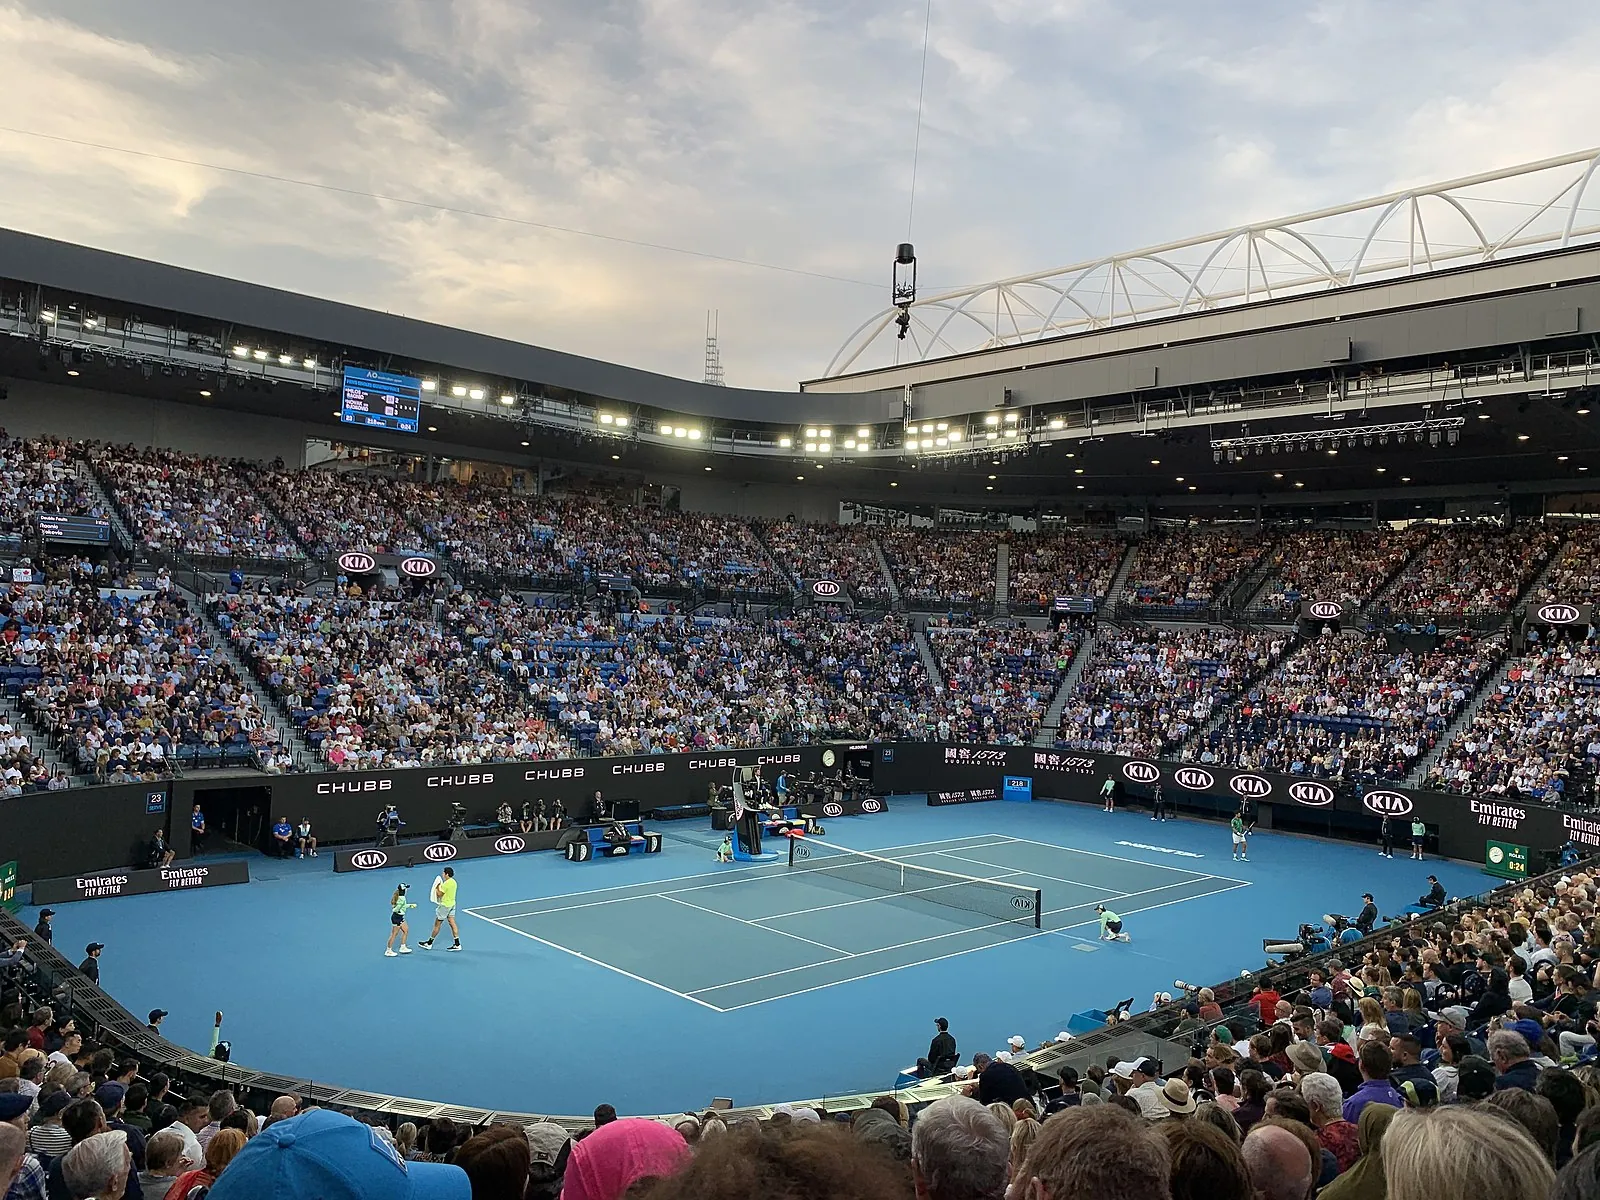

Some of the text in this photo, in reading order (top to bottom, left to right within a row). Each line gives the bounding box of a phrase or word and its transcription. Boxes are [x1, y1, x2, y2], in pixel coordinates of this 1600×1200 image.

[345, 556, 369, 569] KIA
[408, 561, 430, 573] KIA
[817, 583, 835, 593] KIA
[1316, 604, 1338, 615] KIA
[1545, 608, 1573, 620] KIA
[757, 754, 801, 765] CHUBB
[972, 750, 1006, 760] 1573
[612, 762, 665, 775] CHUBB
[689, 758, 737, 769] CHUBB
[1061, 757, 1095, 768] 1573
[525, 767, 584, 781] CHUBB
[1129, 764, 1154, 779] KIA
[427, 773, 494, 787] CHUBB
[1181, 771, 1208, 787] KIA
[316, 779, 392, 794] CHUBB
[1237, 778, 1265, 794] KIA
[151, 794, 162, 803] 23
[1296, 785, 1327, 802] KIA
[1372, 794, 1405, 812] KIA
[1470, 799, 1526, 820] Emirates
[1478, 814, 1518, 830] FLY BETTER
[1569, 829, 1580, 843] FLY
[499, 839, 520, 850] KIA
[429, 846, 452, 858] KIA
[357, 853, 382, 866] KIA
[1509, 861, 1525, 872] 0:24
[160, 867, 209, 880] Emirates
[76, 875, 128, 889] Emirates
[169, 876, 203, 888] FLY BETTER
[84, 885, 121, 897] FLY BETTER
